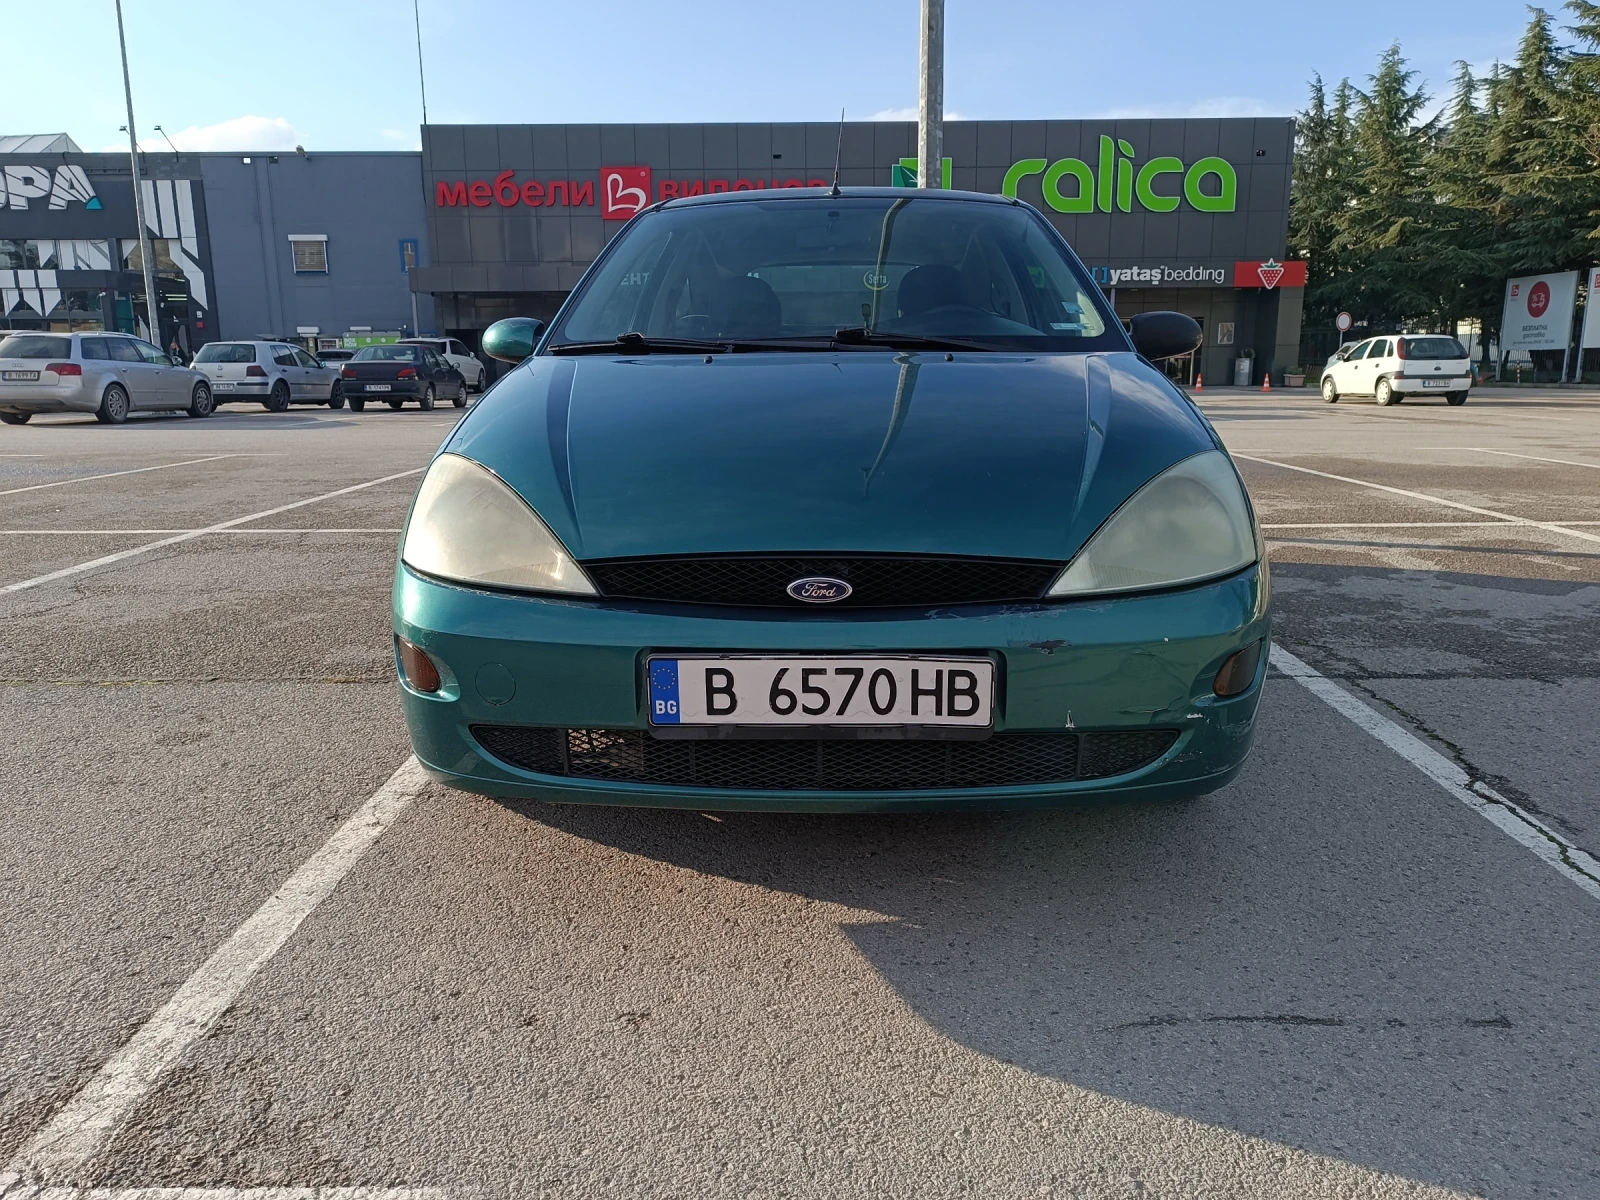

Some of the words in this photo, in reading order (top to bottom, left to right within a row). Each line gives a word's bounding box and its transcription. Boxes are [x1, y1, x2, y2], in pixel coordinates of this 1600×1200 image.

[437, 169, 594, 208] мебели
[1002, 134, 1237, 214] ralica
[801, 582, 837, 597] Ford
[655, 701, 677, 715] BG
[705, 667, 738, 716] B
[768, 667, 898, 717] 6570
[910, 668, 981, 718] HB
